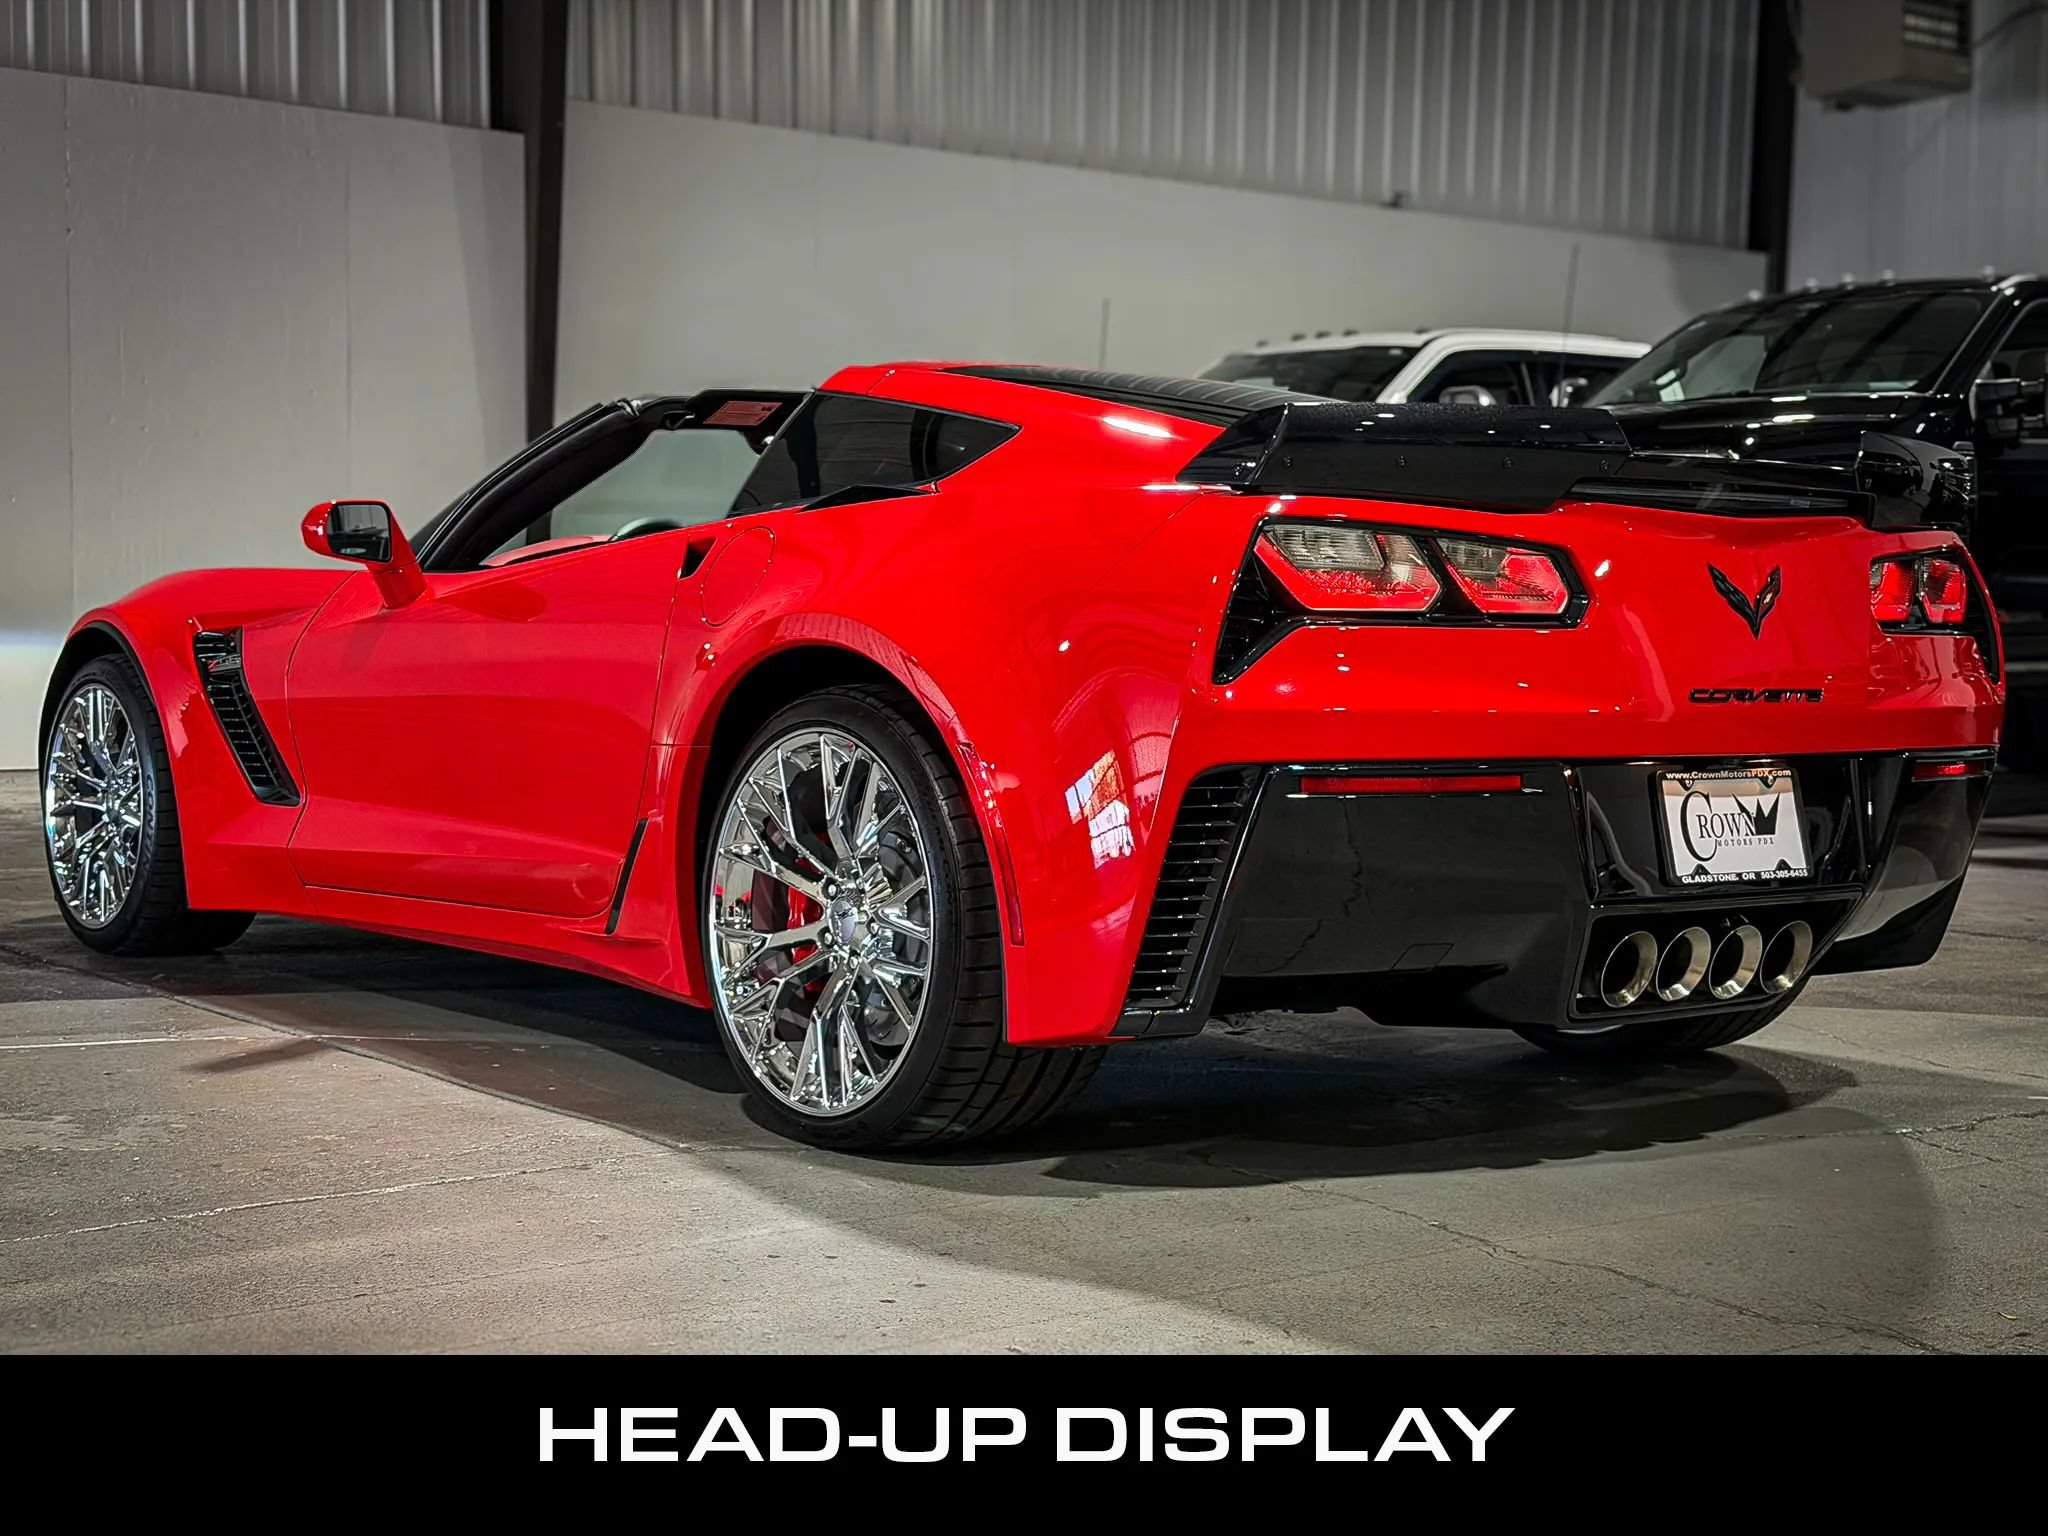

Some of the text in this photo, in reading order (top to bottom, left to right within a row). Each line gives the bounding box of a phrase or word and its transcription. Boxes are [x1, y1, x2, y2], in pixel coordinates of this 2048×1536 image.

[1689, 688, 1825, 703] CORVETTE
[1666, 770, 1791, 779] www.CrownMotorsPDX.com
[1718, 839, 1752, 847] MOTORS
